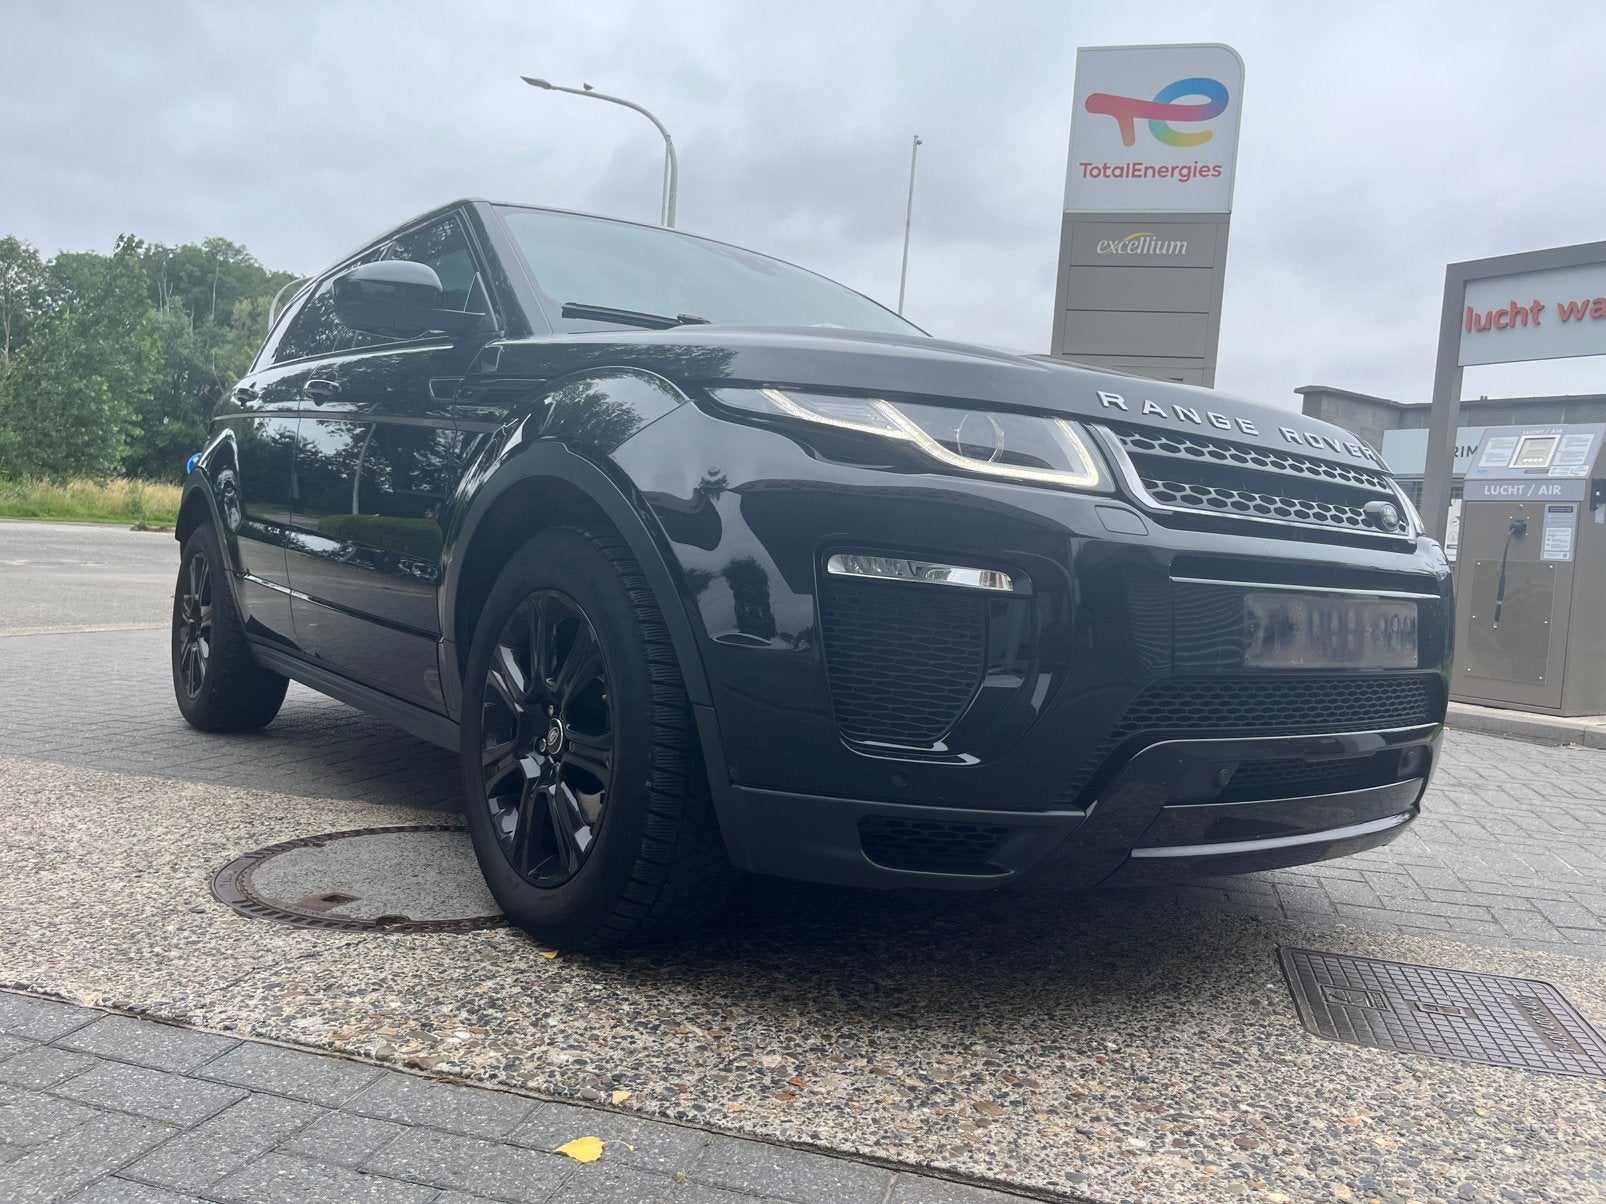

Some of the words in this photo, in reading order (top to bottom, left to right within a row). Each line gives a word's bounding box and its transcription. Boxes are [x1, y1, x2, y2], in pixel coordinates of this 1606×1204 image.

[1079, 161, 1222, 182] TotalEnergies
[1097, 236, 1188, 255] excellium
[1465, 299, 1545, 333] lucht
[1096, 390, 1259, 436] RANGE
[1279, 426, 1377, 462] ROVER
[1484, 485, 1525, 496] LUCHT
[1538, 485, 1562, 496] AIR
